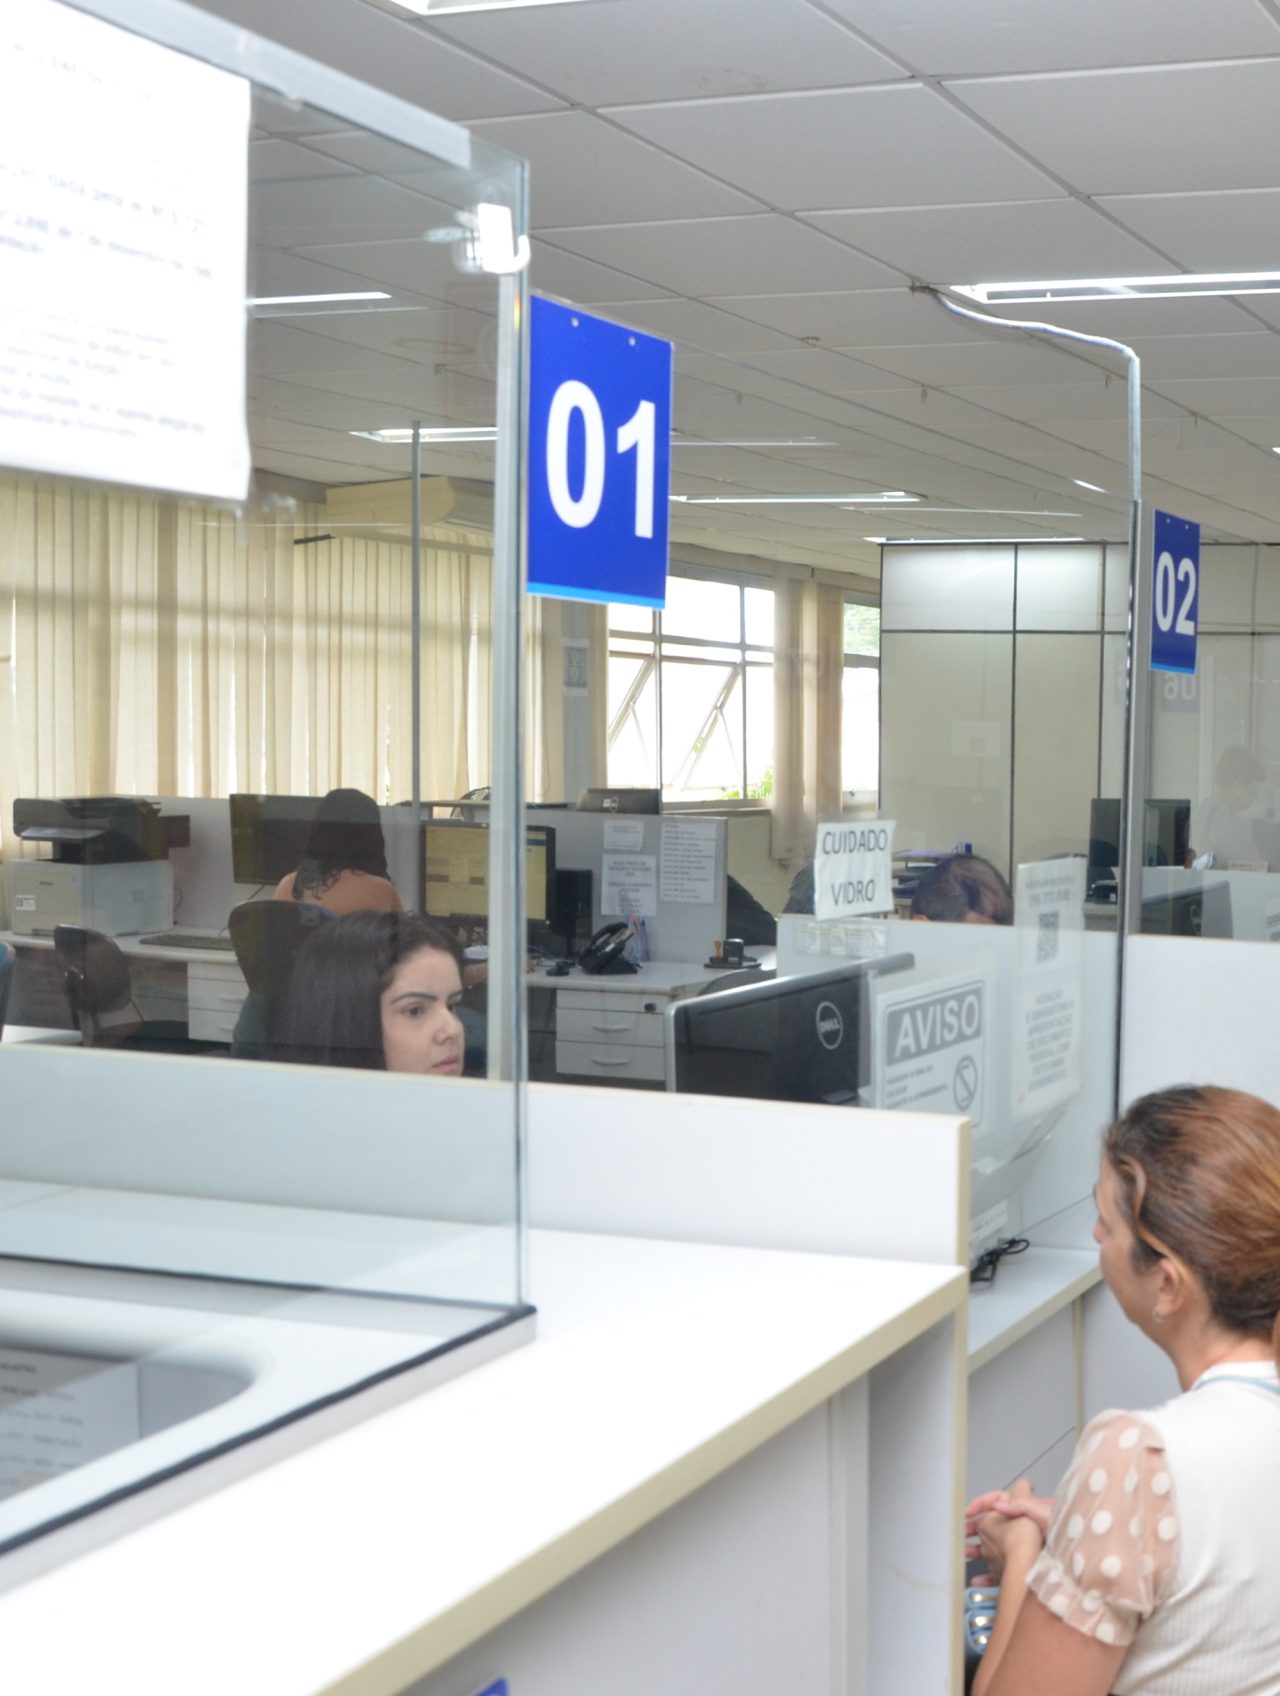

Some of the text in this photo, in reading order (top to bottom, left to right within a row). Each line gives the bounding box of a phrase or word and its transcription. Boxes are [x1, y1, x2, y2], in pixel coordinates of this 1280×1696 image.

[546, 380, 656, 539] 01
[1155, 551, 1197, 637] 02
[823, 828, 889, 855] CUIDADO
[831, 880, 876, 907] VIDRO
[894, 994, 980, 1059] AVISO
